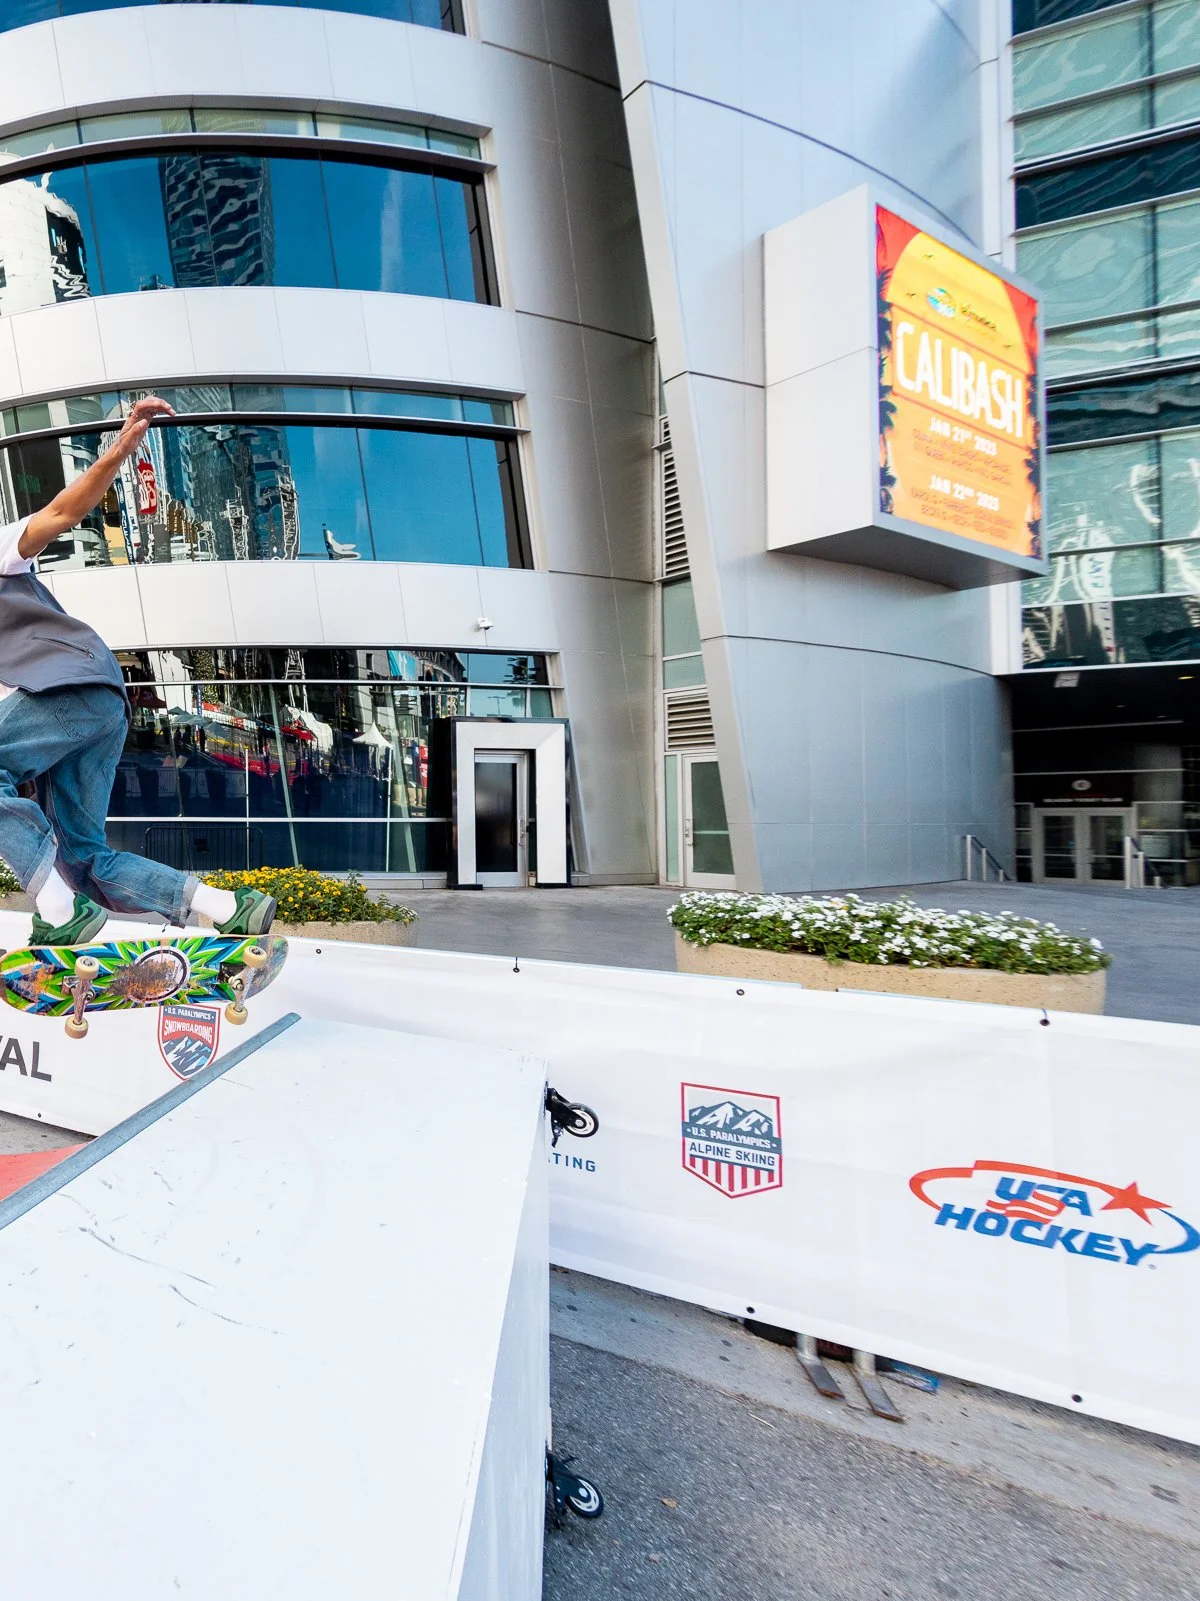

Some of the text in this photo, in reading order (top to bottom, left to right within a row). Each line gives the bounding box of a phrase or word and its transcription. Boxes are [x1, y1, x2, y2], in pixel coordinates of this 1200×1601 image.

[895, 321, 1023, 438] CALIBASH
[167, 1007, 212, 1020] U.S. PARALYMPICS
[163, 1019, 213, 1044] SNOWBOARDING
[691, 1126, 772, 1149] U.S. PARALYMPICS
[548, 1152, 596, 1172] TING
[689, 1141, 775, 1167] ALPINE SKIING
[987, 1176, 1094, 1222] USA
[934, 1203, 1160, 1267] HOCKEY
